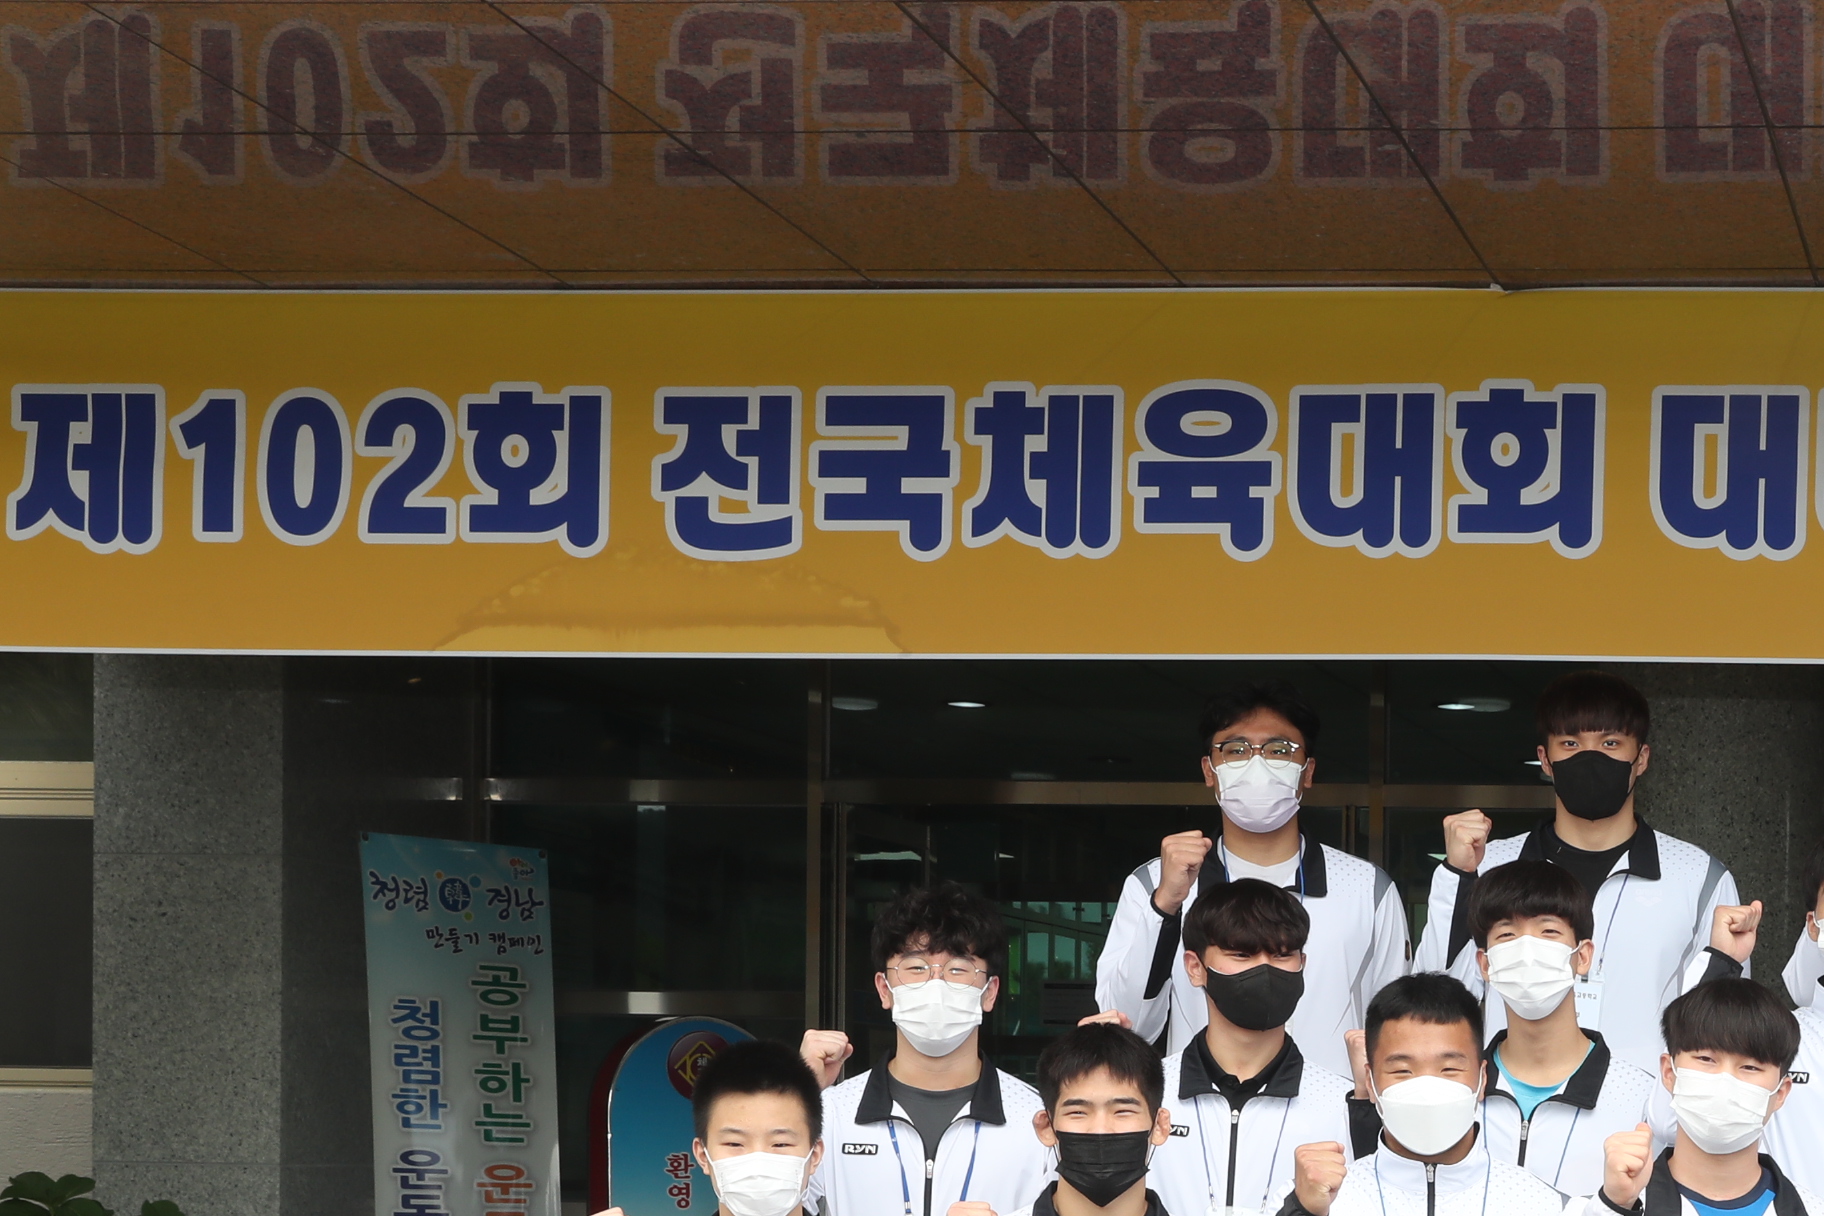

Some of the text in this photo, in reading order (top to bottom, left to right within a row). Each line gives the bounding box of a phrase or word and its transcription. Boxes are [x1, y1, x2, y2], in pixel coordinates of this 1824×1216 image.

[18, 394, 599, 546] 제102회
[663, 390, 1594, 550] 전국체육대회
[369, 872, 429, 912] 청렴
[486, 886, 544, 920] 경남
[426, 926, 544, 955] 만들기 캠페인
[391, 998, 448, 1131] 청렴한
[471, 963, 532, 1146] 공부하는
[844, 1145, 876, 1153] RYN
[665, 1153, 694, 1208] 환영
